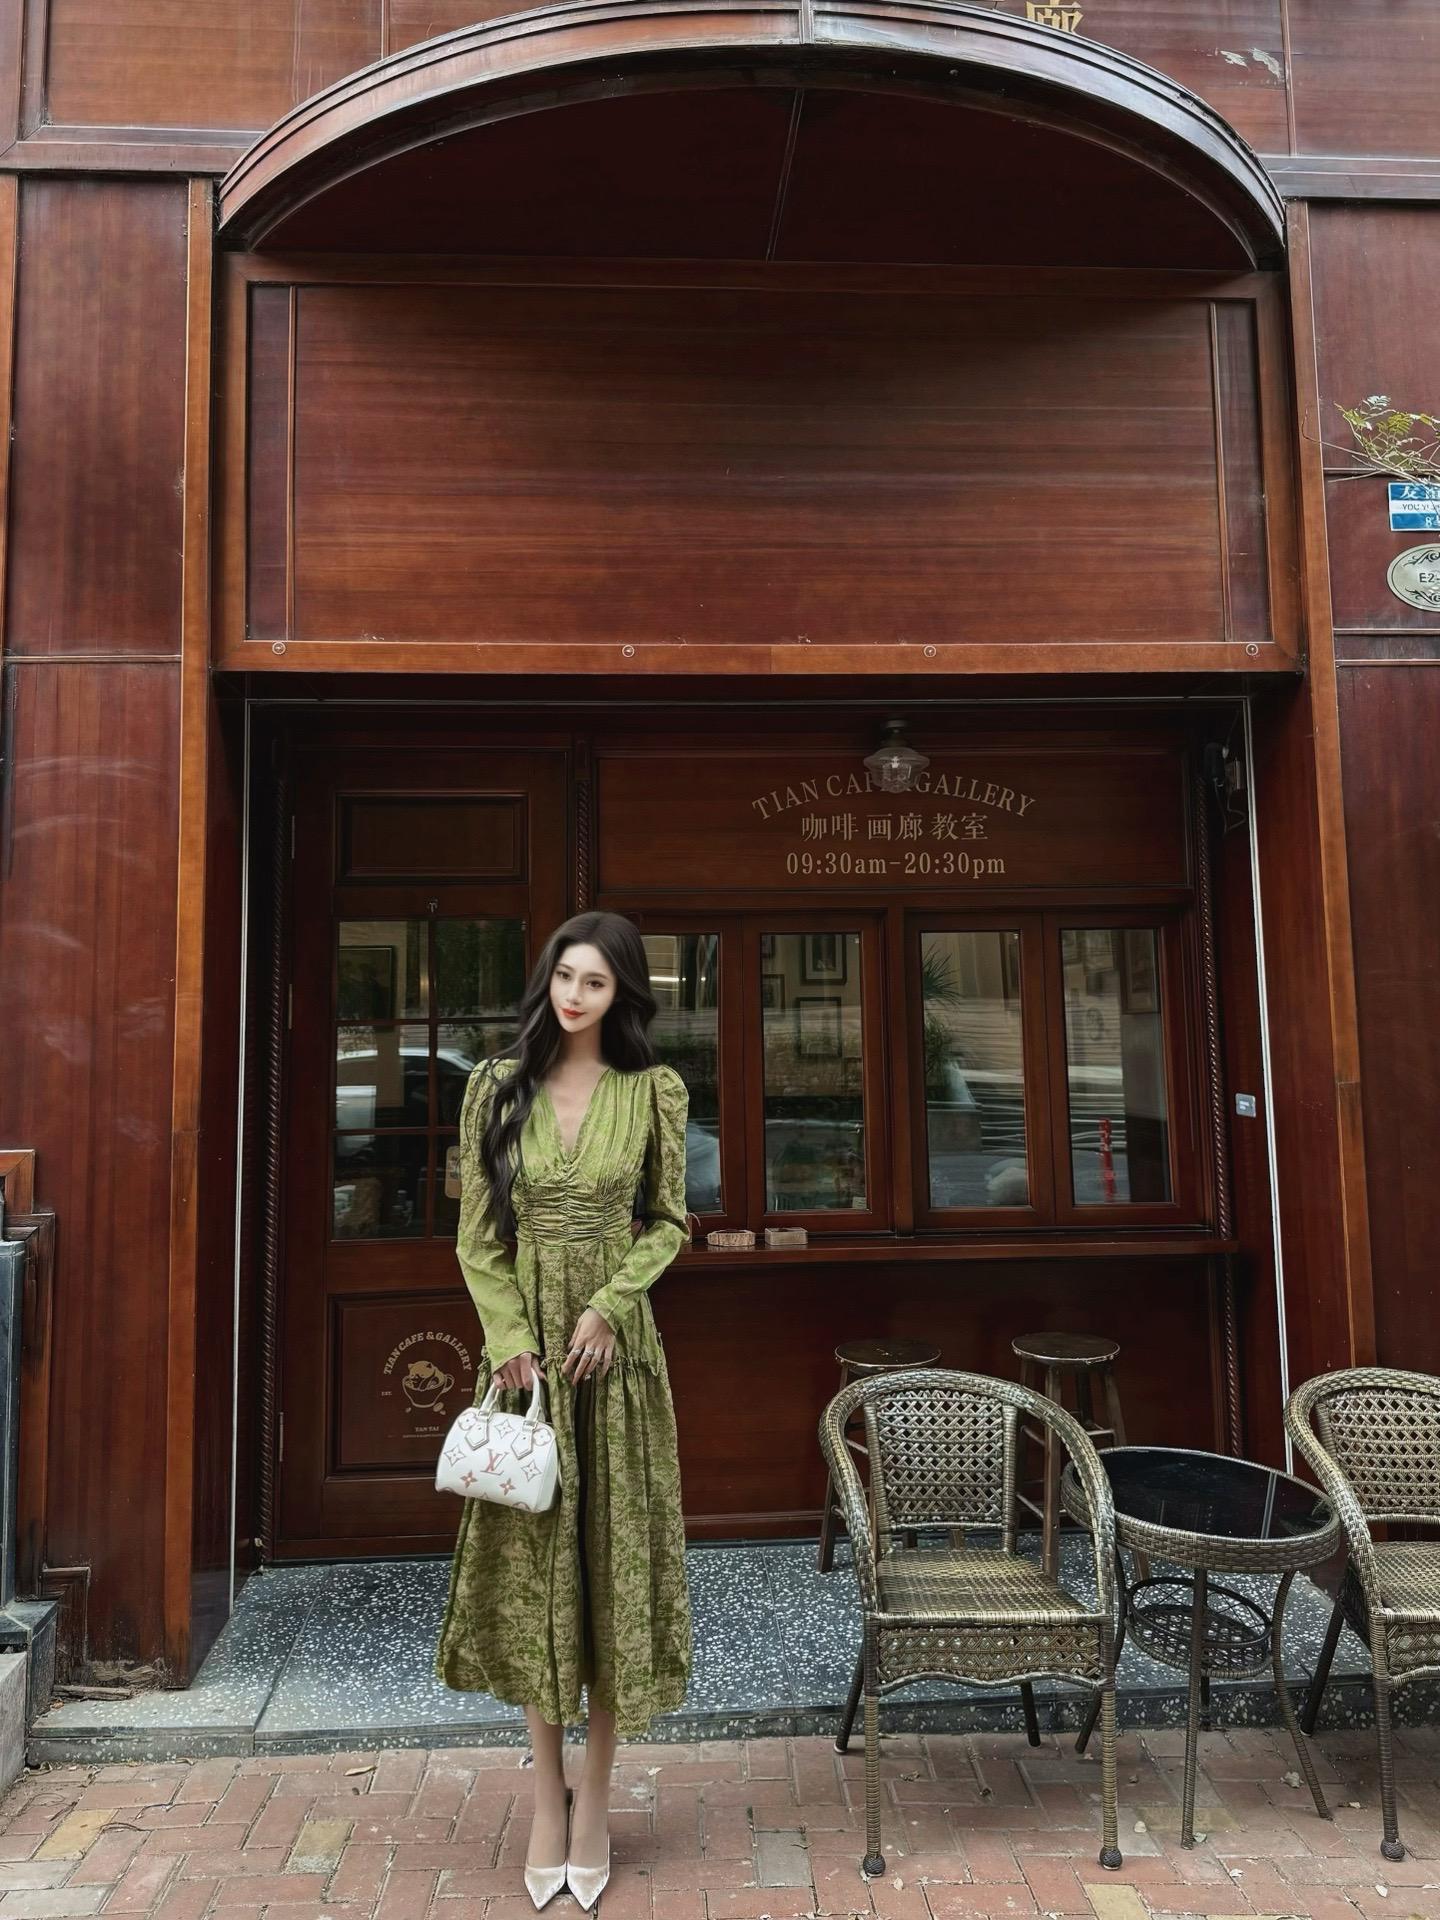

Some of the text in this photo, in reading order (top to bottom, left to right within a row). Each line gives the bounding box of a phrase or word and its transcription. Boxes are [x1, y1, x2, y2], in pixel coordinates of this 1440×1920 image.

[752, 778, 821, 820] TIAN
[826, 771, 890, 797] CAF
[915, 771, 1037, 817] GALLERY
[800, 812, 988, 842] 咖啡画廊教室
[786, 851, 1006, 879] 09:30am-20:30pm
[383, 1348, 401, 1376] TIAN
[398, 1332, 424, 1351] CAFE
[436, 1331, 472, 1371] GALLERY
